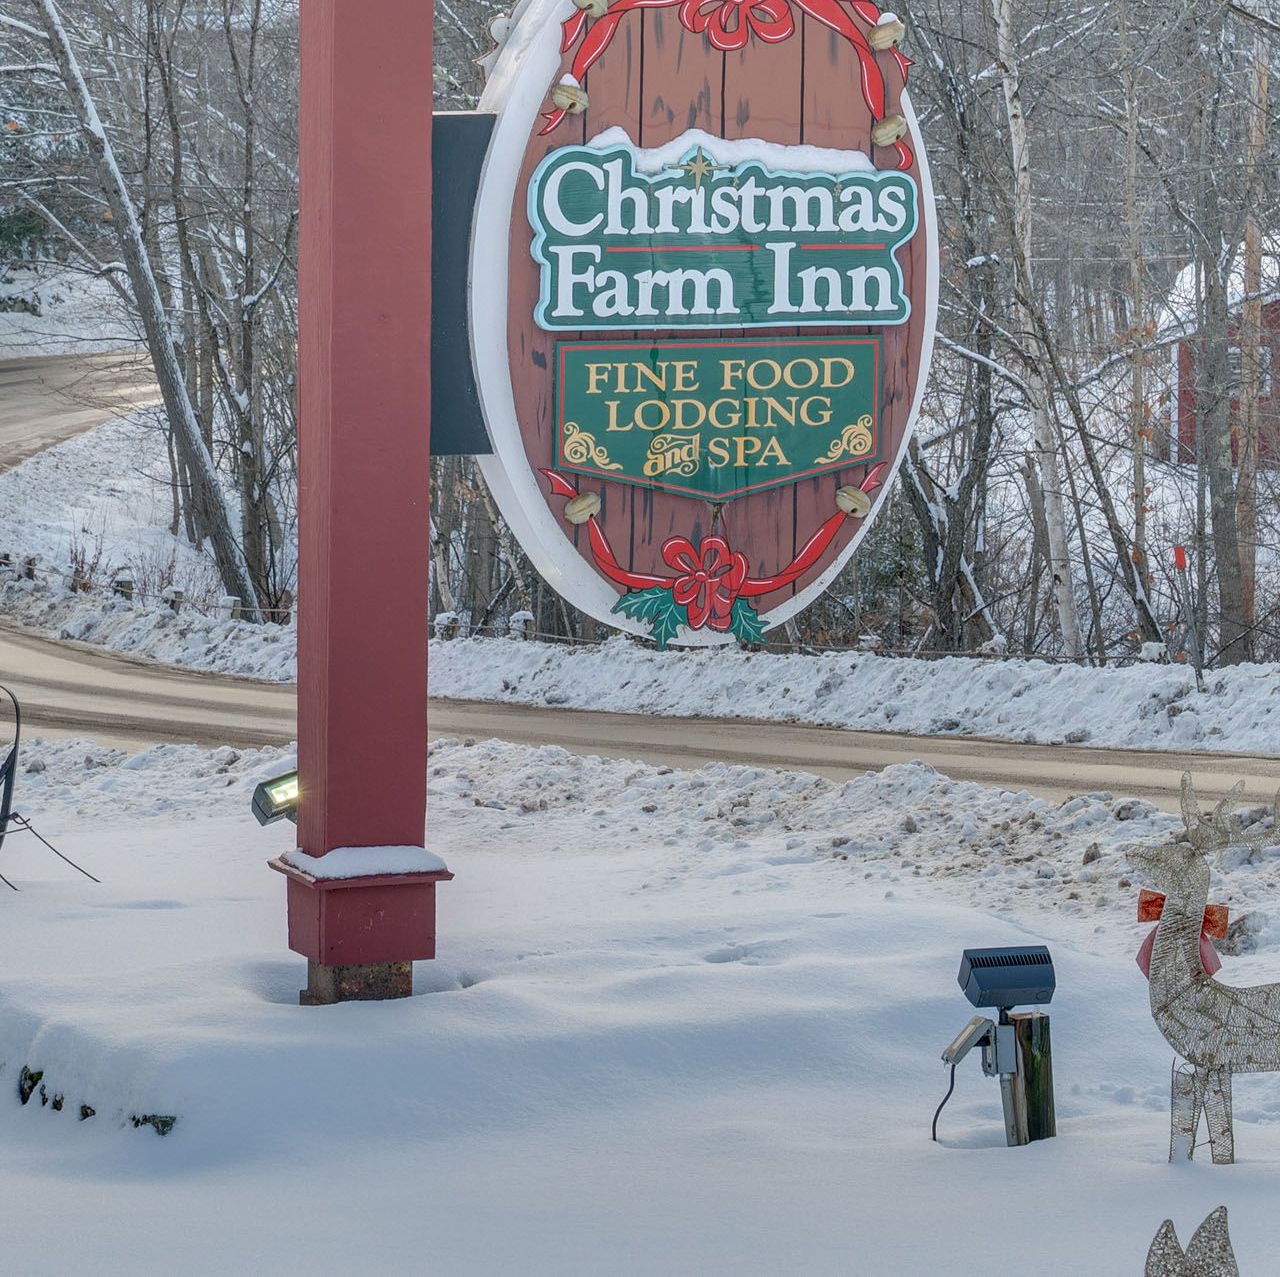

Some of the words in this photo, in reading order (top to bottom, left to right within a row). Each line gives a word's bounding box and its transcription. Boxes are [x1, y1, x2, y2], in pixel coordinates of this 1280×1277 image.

[543, 159, 908, 236] Christmas
[548, 244, 740, 317] Farm
[765, 242, 899, 315] Inn
[585, 360, 700, 394] FINE
[719, 357, 856, 391] FOOD
[604, 396, 834, 432] LODGING
[643, 432, 701, 477] and
[707, 435, 792, 467] SPA
